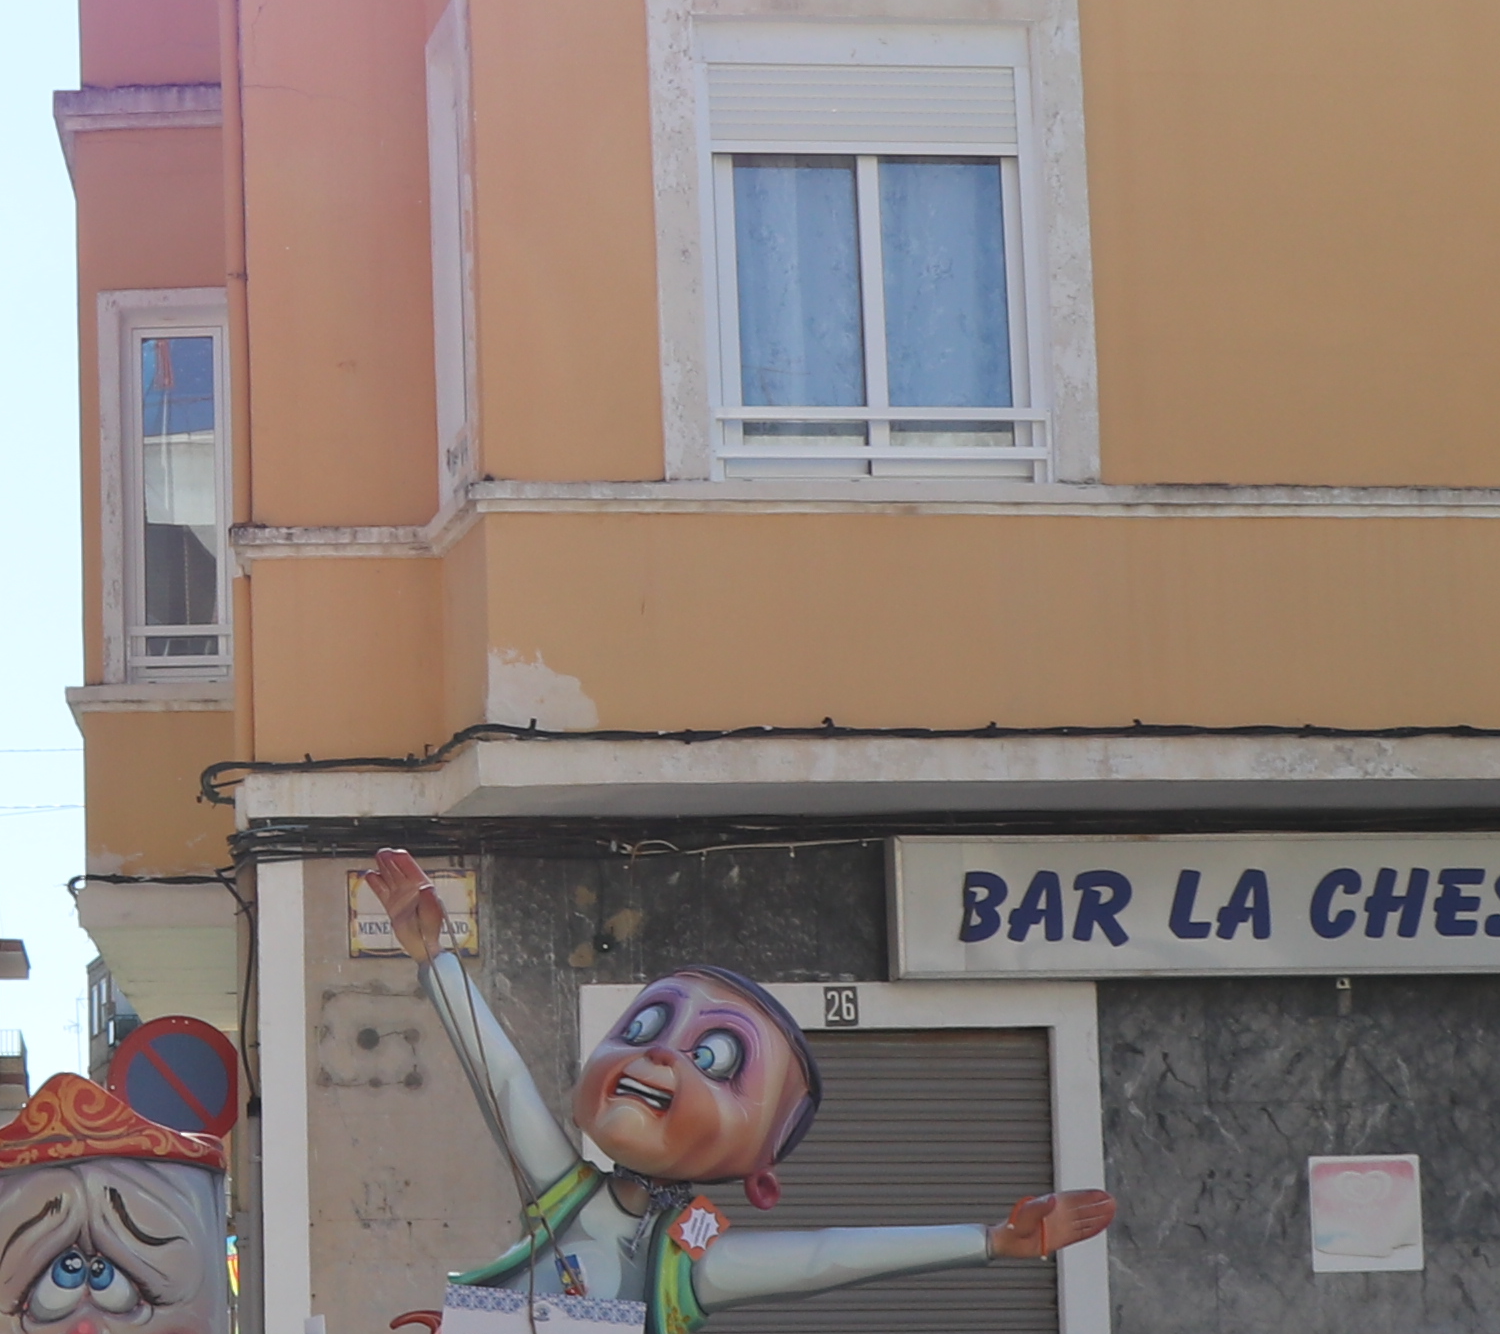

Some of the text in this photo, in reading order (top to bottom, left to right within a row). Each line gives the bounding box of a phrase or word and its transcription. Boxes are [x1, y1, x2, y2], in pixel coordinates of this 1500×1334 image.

[958, 870, 1133, 947] BAR
[1167, 867, 1272, 941] LA
[357, 920, 469, 935] MENÉ LAYO
[826, 989, 857, 1024] 26
